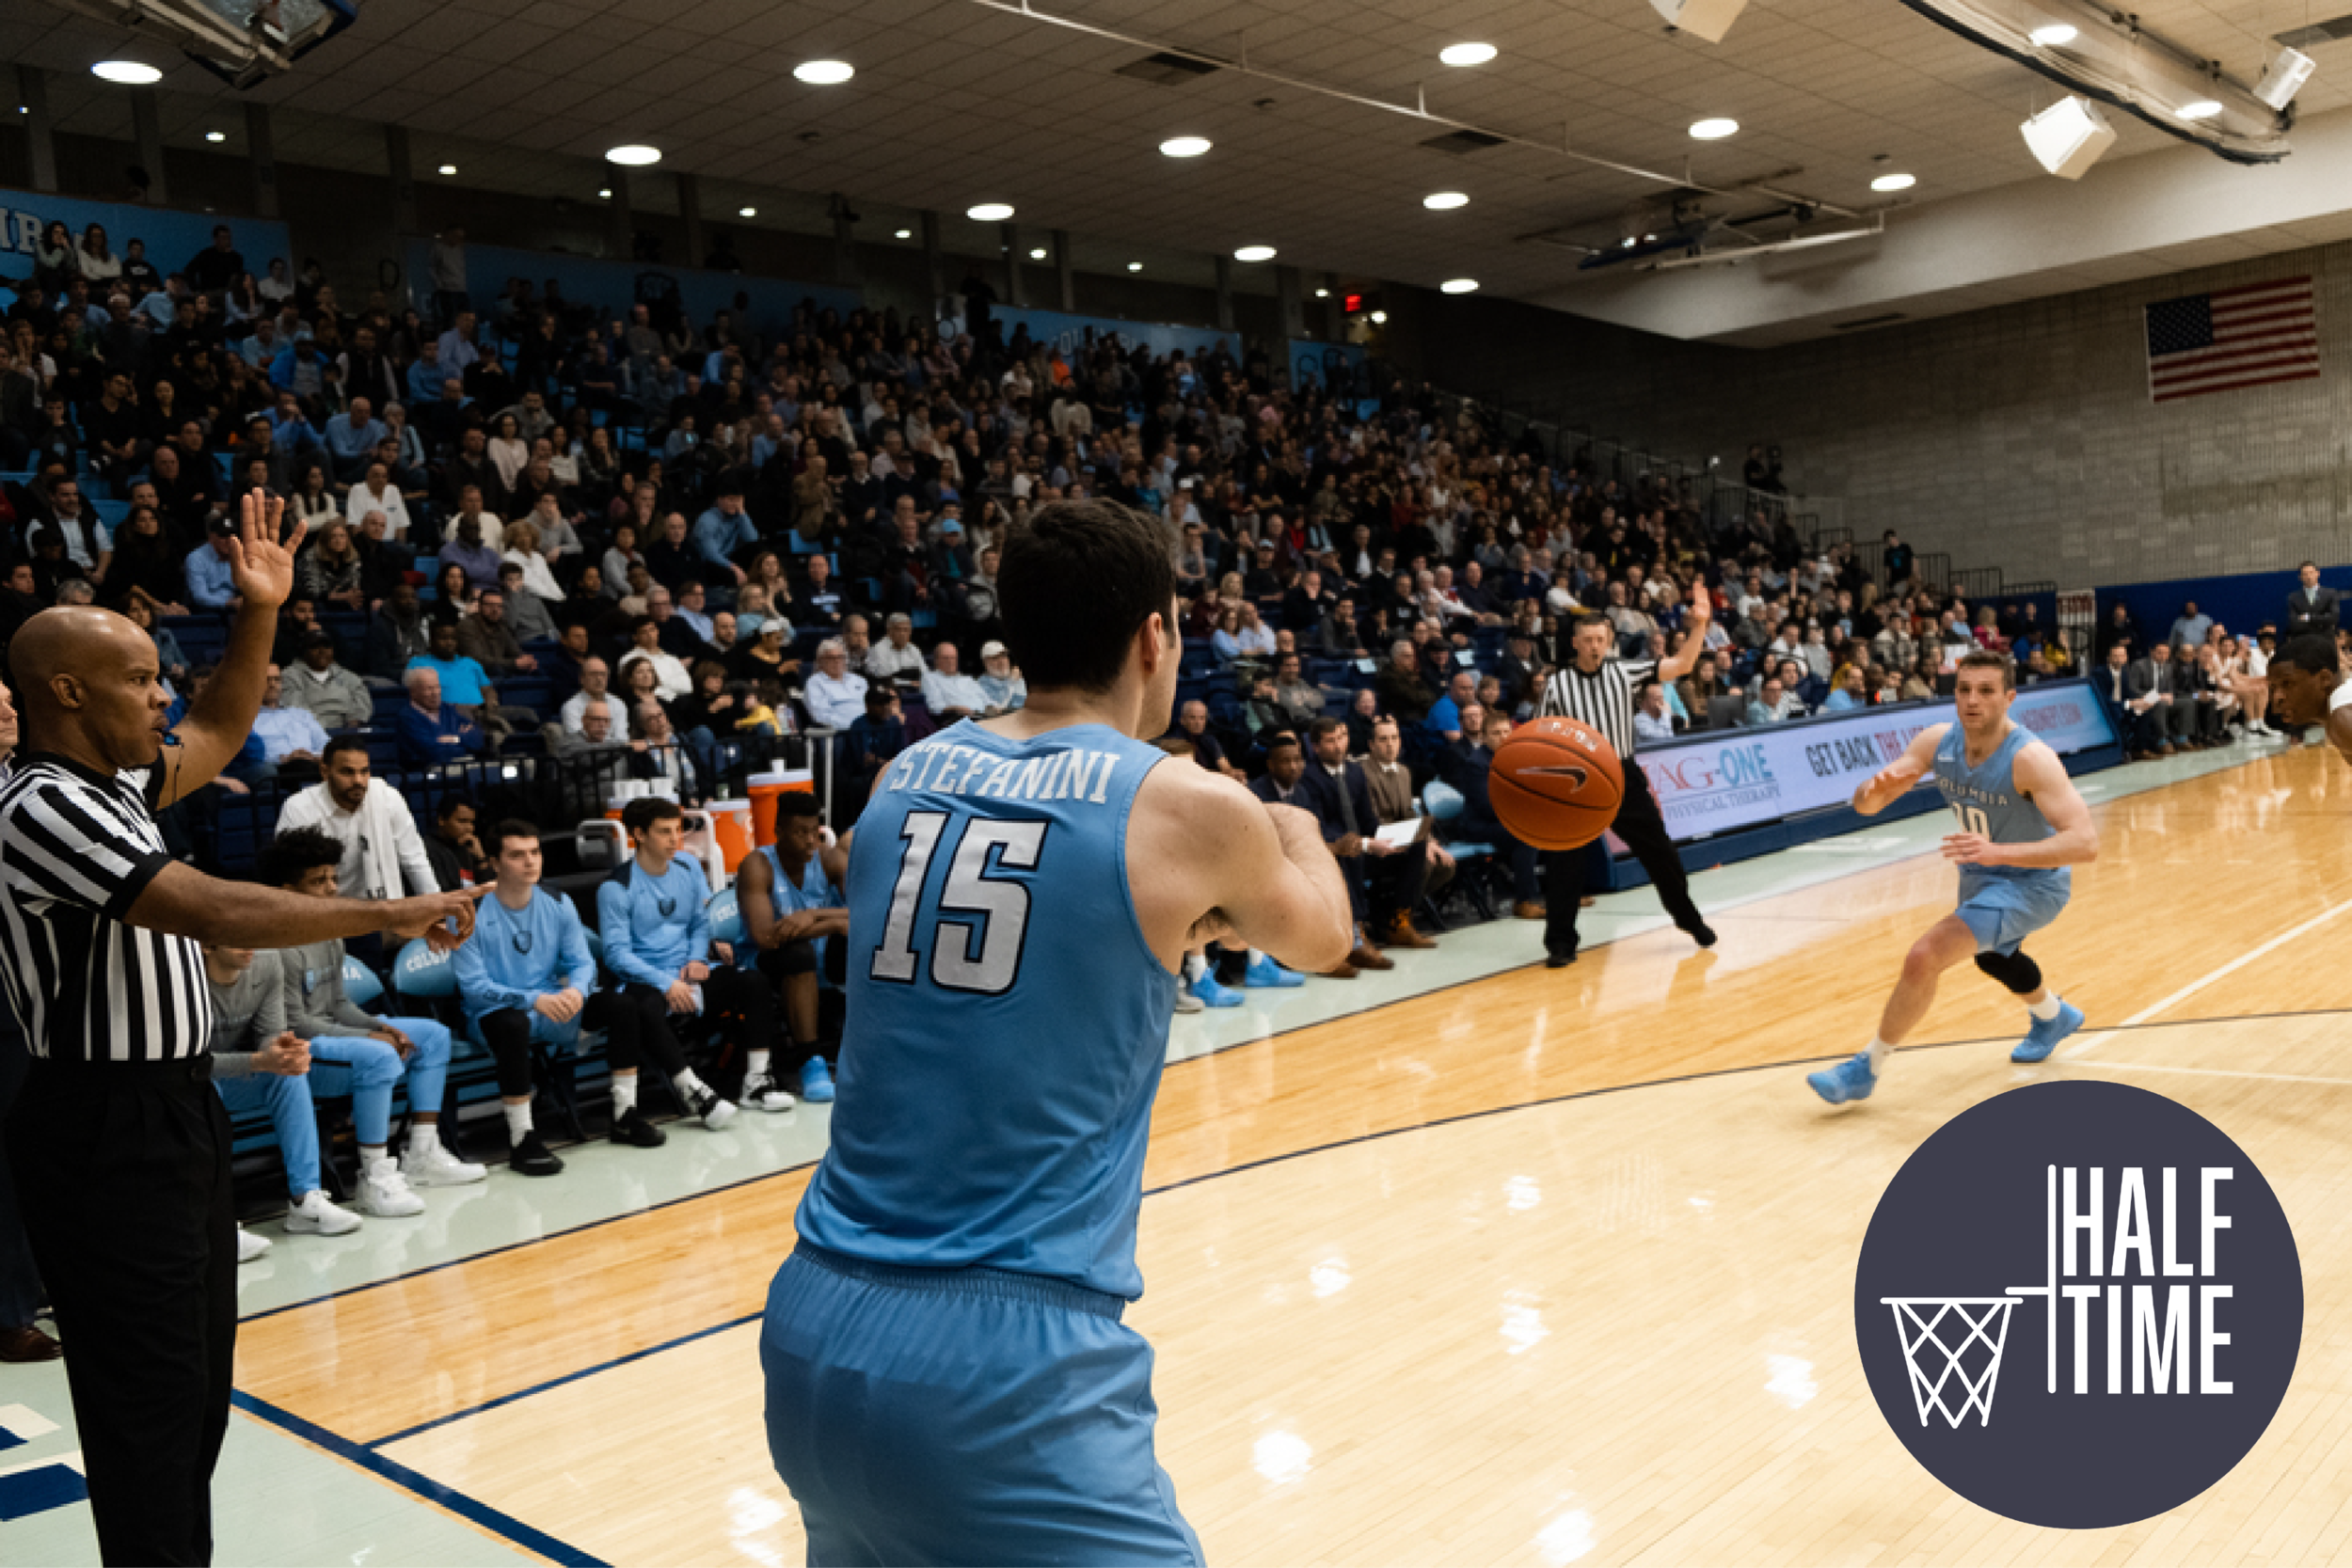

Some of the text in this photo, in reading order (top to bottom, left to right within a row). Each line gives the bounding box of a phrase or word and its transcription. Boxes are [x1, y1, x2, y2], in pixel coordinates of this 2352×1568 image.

[889, 741, 1121, 804] STEFANINI
[1805, 742, 1839, 777] GET
[1834, 734, 1882, 773] BACK
[1664, 796, 1727, 821] PHYSICAL
[869, 810, 1052, 997] 15
